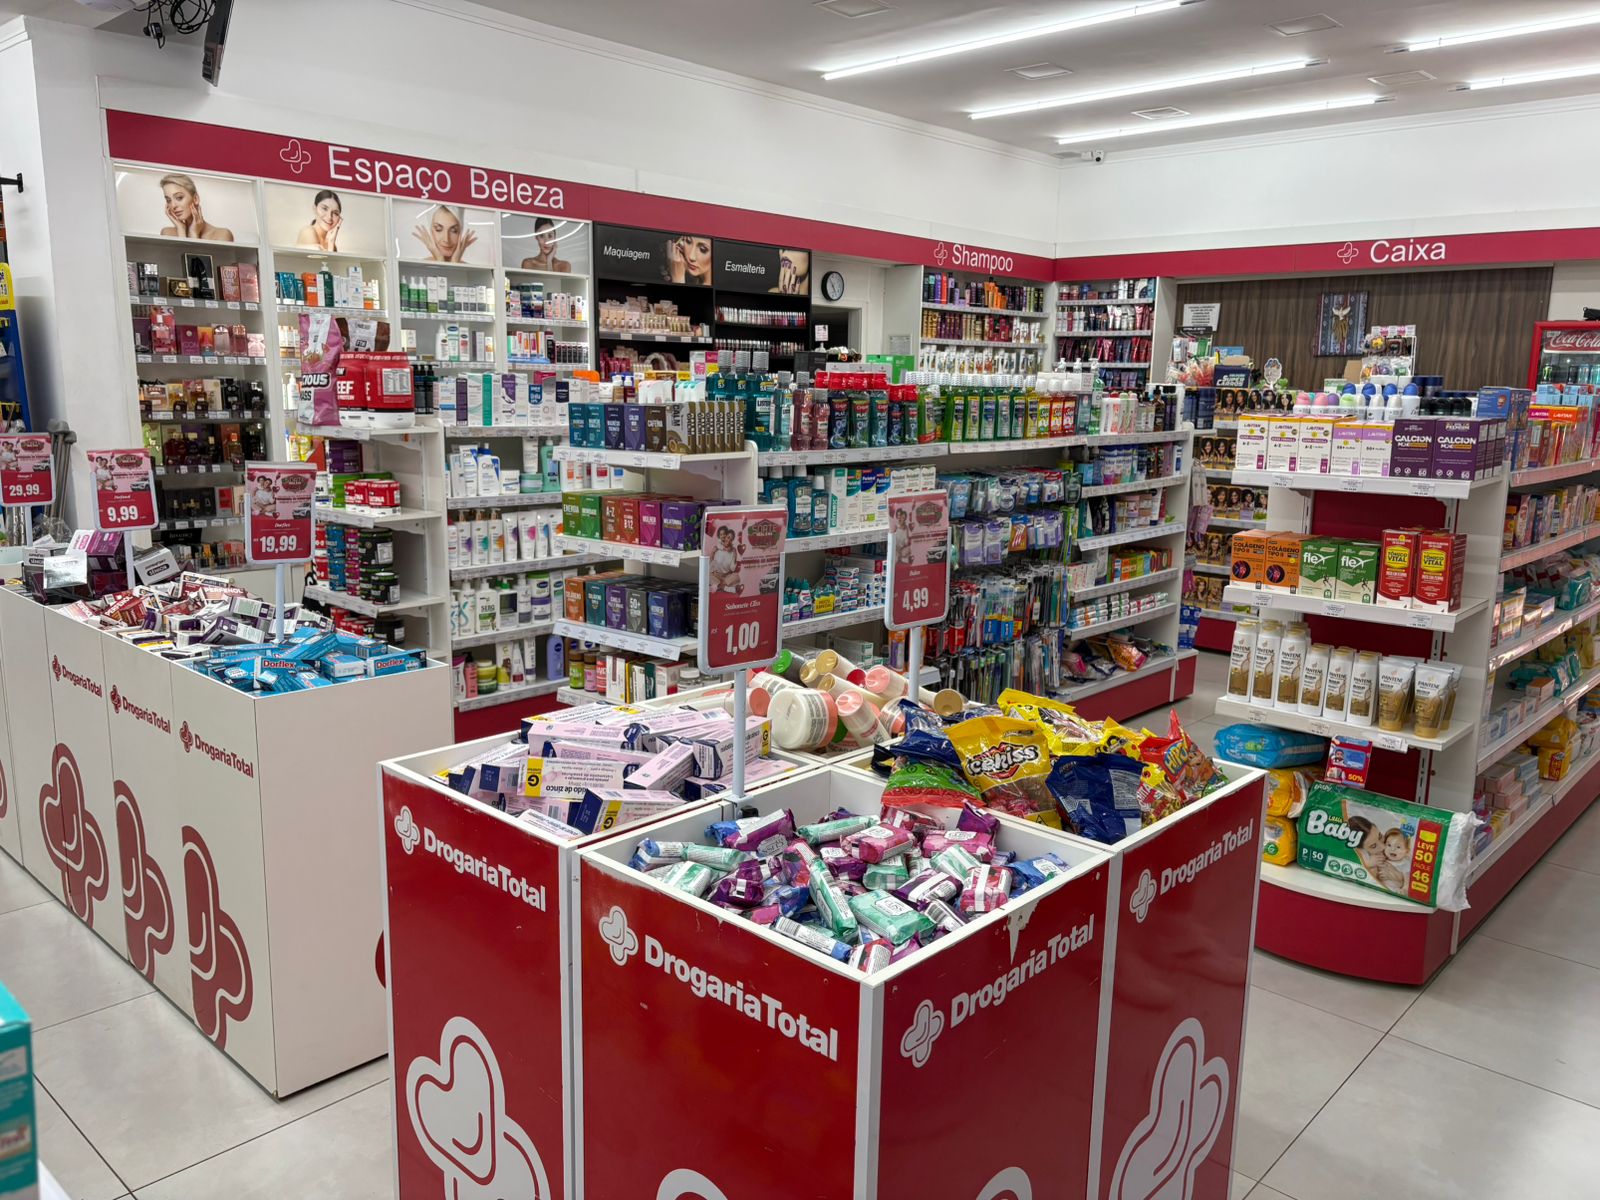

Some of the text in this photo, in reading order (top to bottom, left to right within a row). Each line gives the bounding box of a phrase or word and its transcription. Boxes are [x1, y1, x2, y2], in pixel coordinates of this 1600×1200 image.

[327, 144, 565, 210] Espaço Beleza
[603, 245, 651, 260] Maquiagem
[1370, 239, 1447, 264] Caixa
[952, 243, 1014, 275] Shampoo
[724, 260, 766, 275] Esmalteria
[1395, 434, 1432, 444] CALCION
[1437, 436, 1477, 445] CALCION
[9, 483, 40, 497] 29,99
[107, 505, 138, 523] 9,99
[259, 535, 297, 553] 19,99
[1233, 541, 1265, 550] COLÁGENO
[1267, 545, 1300, 553] COLÁGENO
[1303, 552, 1336, 565] flex
[1340, 555, 1374, 568] flex
[725, 602, 748, 610] Sabonete
[903, 587, 929, 612] 4,99
[725, 621, 760, 655] 1,00
[263, 659, 295, 669] Dorflex
[376, 659, 404, 670] Dorflex
[62, 665, 102, 698] DrogariaTotal
[122, 696, 171, 734] DrogariaTotal
[194, 734, 254, 779] DrogariaTotal
[527, 774, 540, 787] G
[564, 786, 573, 794] de
[603, 816, 614, 829] G
[1307, 809, 1365, 848] Baby
[1417, 841, 1435, 851] LEVE
[1159, 818, 1253, 895] DrogariaTotal
[1312, 852, 1324, 860] 50
[1415, 850, 1433, 863] 50
[424, 826, 546, 912] DrogariaTotal
[1412, 870, 1430, 883] 46
[950, 915, 1094, 1029] DrogariaTotal
[644, 934, 838, 1062] DrogariaTotal
